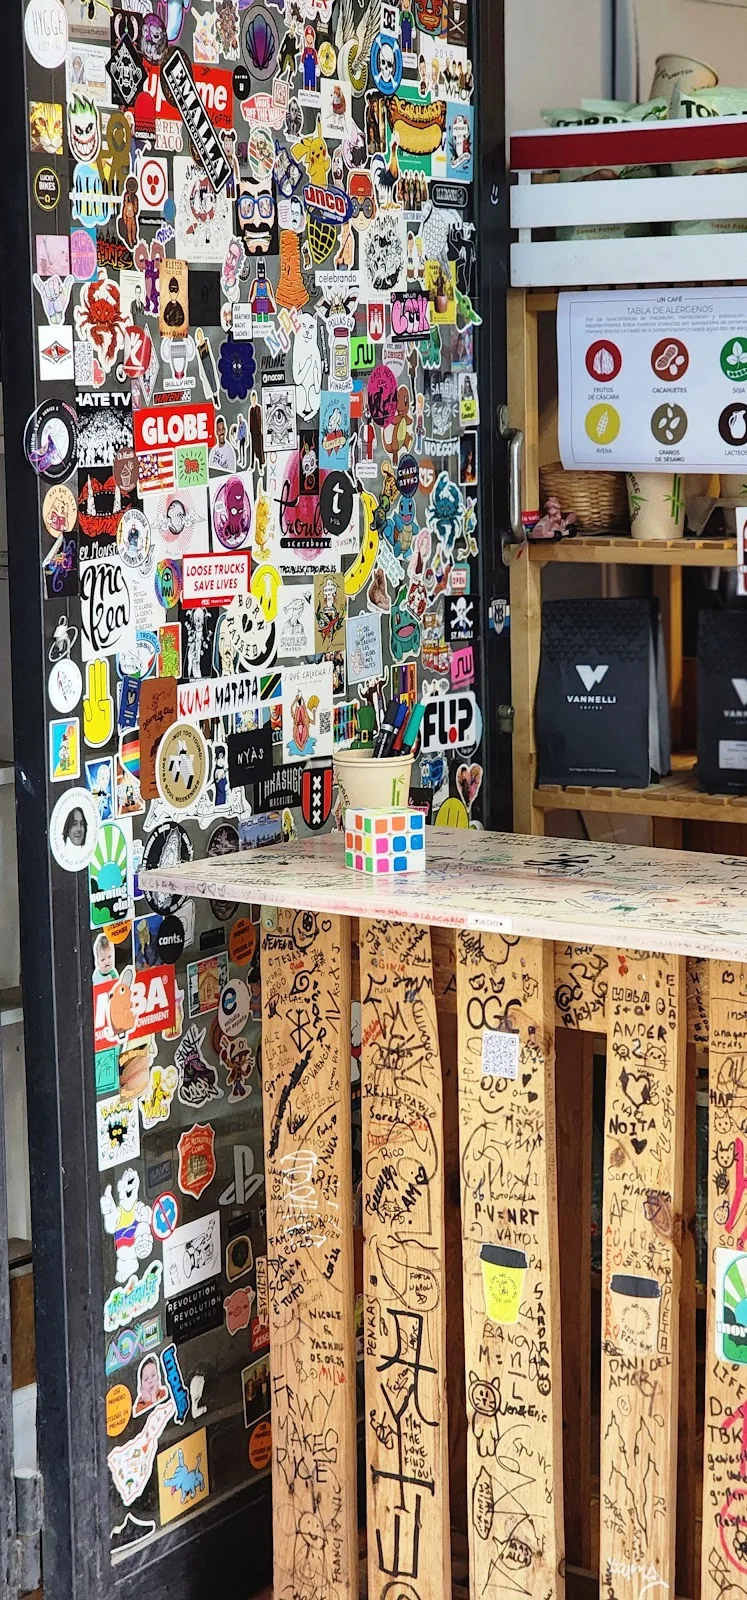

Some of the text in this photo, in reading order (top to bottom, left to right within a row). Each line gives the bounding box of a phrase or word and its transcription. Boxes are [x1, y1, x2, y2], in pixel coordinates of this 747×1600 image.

[32, 10, 64, 35] HYGGE
[435, 48, 454, 59] 2019
[255, 97, 272, 107] VANS
[254, 107, 265, 117] THE
[155, 135, 183, 152] TACO
[39, 182, 56, 191] BIKES
[319, 274, 356, 284] celebrando
[665, 305, 713, 313] ALÉRGENOS
[329, 381, 352, 390] VINAGRE
[111, 393, 131, 407] TV
[186, 563, 245, 576] LOOSE TRUCKS
[194, 579, 238, 591] SAVE LIVES
[452, 576, 465, 585] OPEN
[179, 676, 258, 716] KUNA MATATA
[567, 695, 616, 704] VANNELLI
[113, 898, 134, 912] club
[158, 933, 183, 945] cants.
[225, 1013, 240, 1027] estudia
[613, 1021, 668, 1043] ANDER
[609, 1121, 656, 1137] NOITA
[284, 1236, 313, 1255] 2025
[167, 1284, 216, 1312] REVOLUTION
[174, 1296, 222, 1320] REVOLUTION
[709, 1396, 744, 1418] Das
[707, 1424, 743, 1445] TBK
